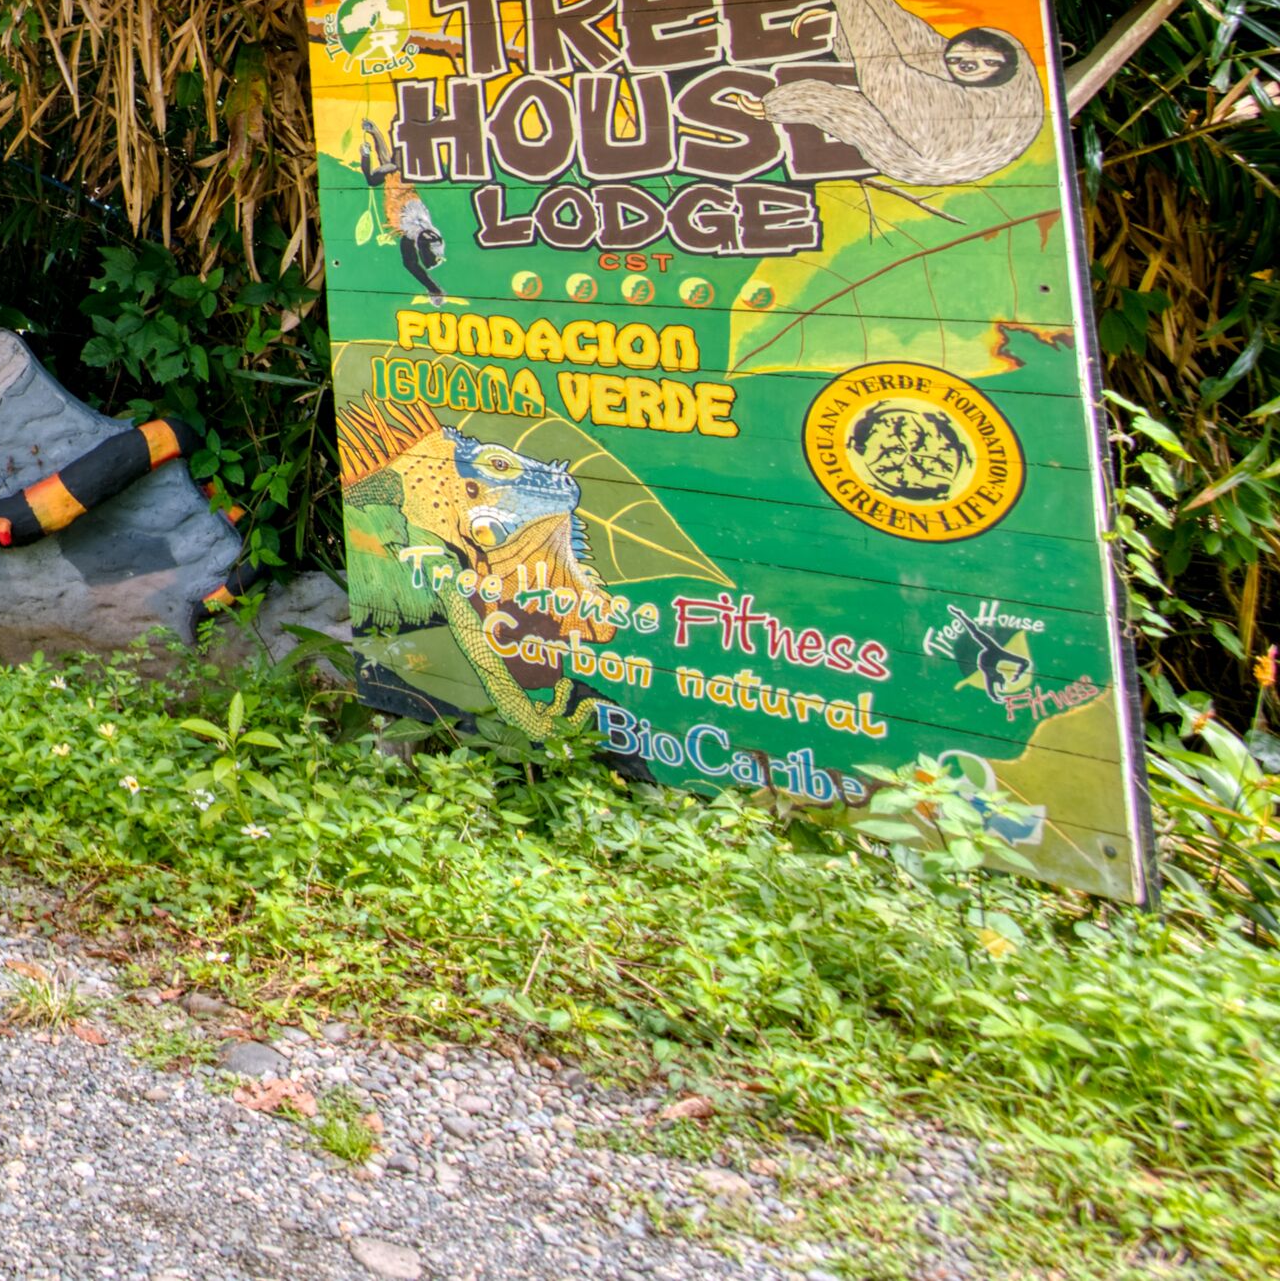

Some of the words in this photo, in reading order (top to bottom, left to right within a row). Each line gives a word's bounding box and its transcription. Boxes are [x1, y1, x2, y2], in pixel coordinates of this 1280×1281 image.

[324, 13, 344, 61] Tree
[360, 43, 420, 76] Lodge
[394, 62, 880, 182] HOUSE
[473, 182, 822, 257] LODGE
[598, 252, 674, 273] CST
[396, 310, 701, 373] FUNDACION
[371, 357, 546, 418] IGUANA
[557, 371, 740, 438] VERDE
[816, 398, 850, 476] IGUANA
[845, 375, 932, 398] VERDE
[942, 386, 1008, 489] FOUNDATION
[836, 478, 930, 535] GREEN
[937, 485, 1003, 533] LIFE
[399, 545, 504, 603] Tree
[514, 561, 660, 633] House
[672, 592, 891, 681] Fitness
[923, 618, 965, 660] Tree
[974, 600, 1045, 633] House
[482, 611, 654, 688] Carbon
[676, 666, 888, 738] natural
[1003, 674, 1100, 722] Fitness
